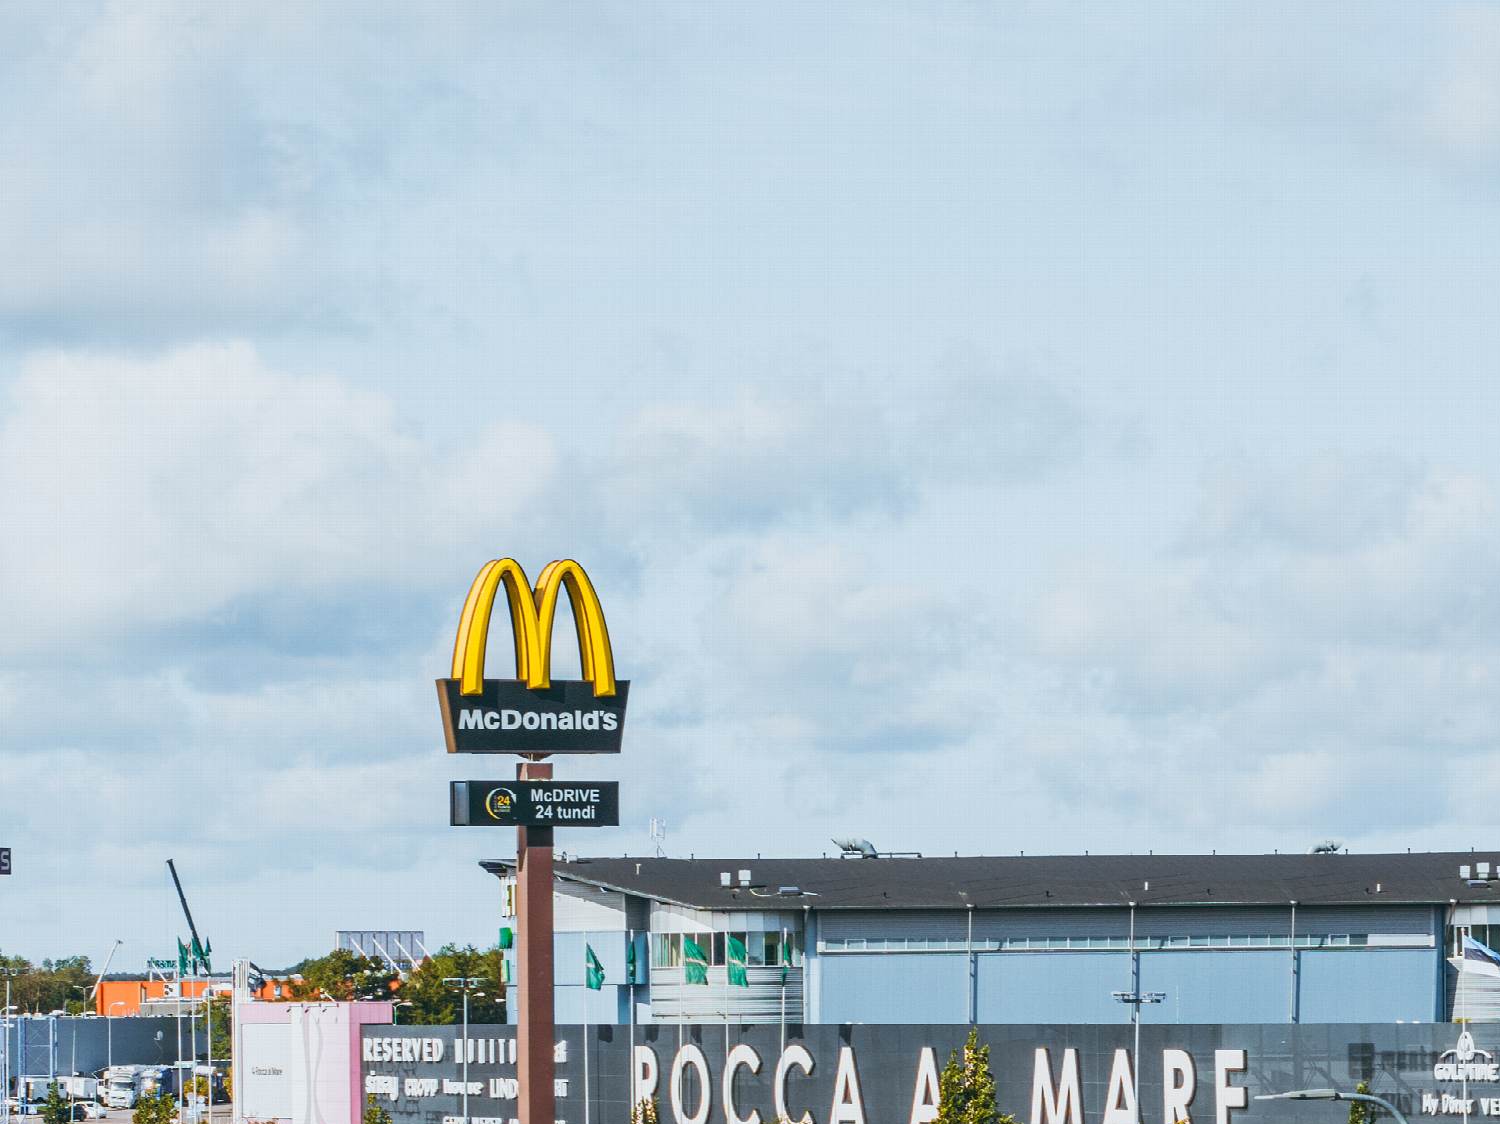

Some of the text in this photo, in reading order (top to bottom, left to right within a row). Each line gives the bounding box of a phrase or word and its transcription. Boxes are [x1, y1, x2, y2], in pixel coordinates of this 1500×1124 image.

[458, 709, 618, 730] McDonald's
[531, 788, 600, 802] McDRIVE
[535, 804, 596, 819] 24 tundi
[363, 1037, 444, 1062] RESERVED
